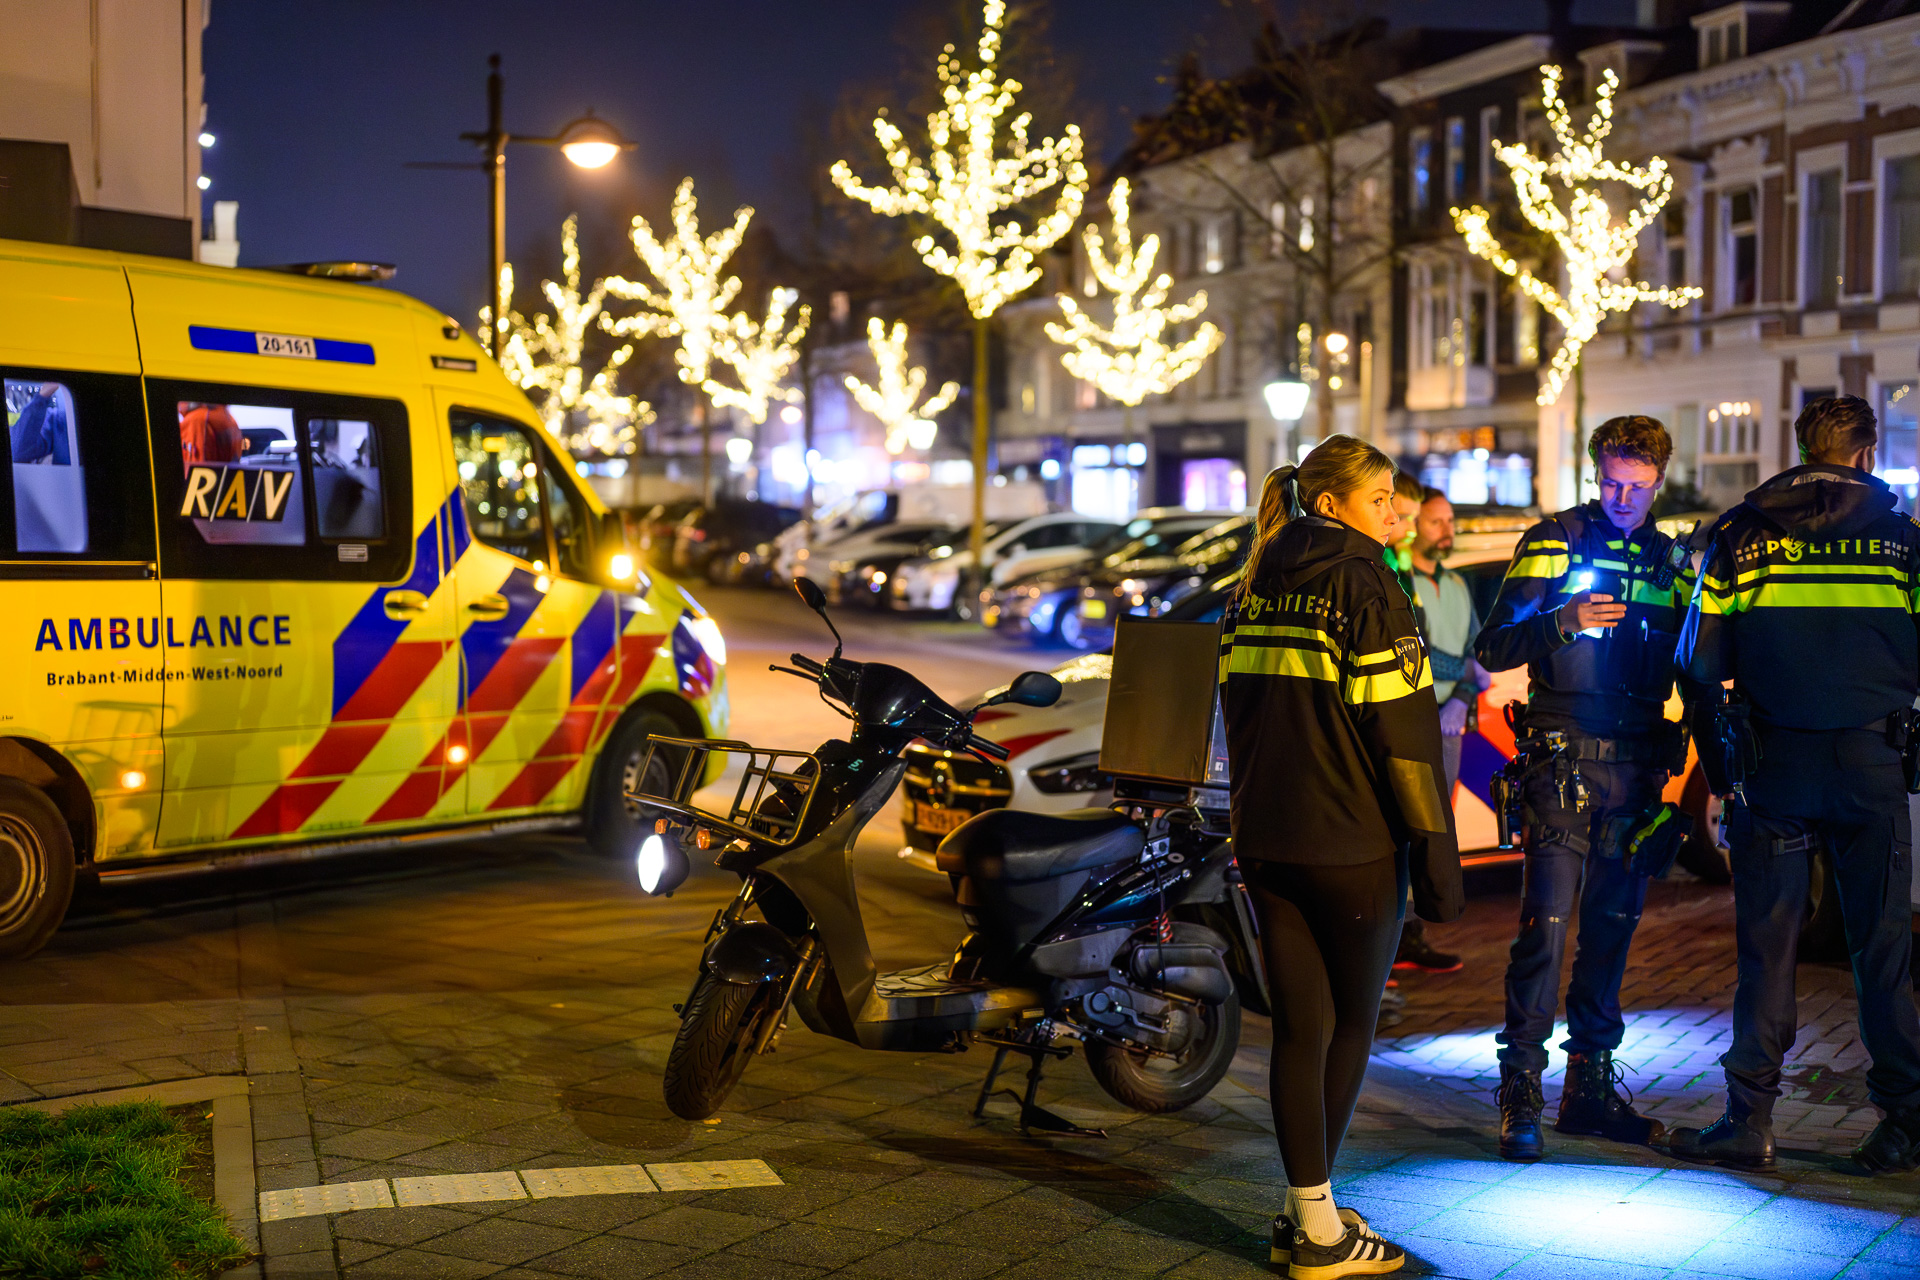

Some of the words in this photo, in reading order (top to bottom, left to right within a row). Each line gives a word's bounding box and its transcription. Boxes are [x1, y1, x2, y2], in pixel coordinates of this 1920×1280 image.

[261, 336, 311, 355] 20-161
[1766, 535, 1881, 562] POLITIE
[1239, 593, 1317, 620] POLITIE
[35, 615, 291, 651] AMBULANCE
[46, 664, 283, 686] Brabant-Midden-West-Noord
